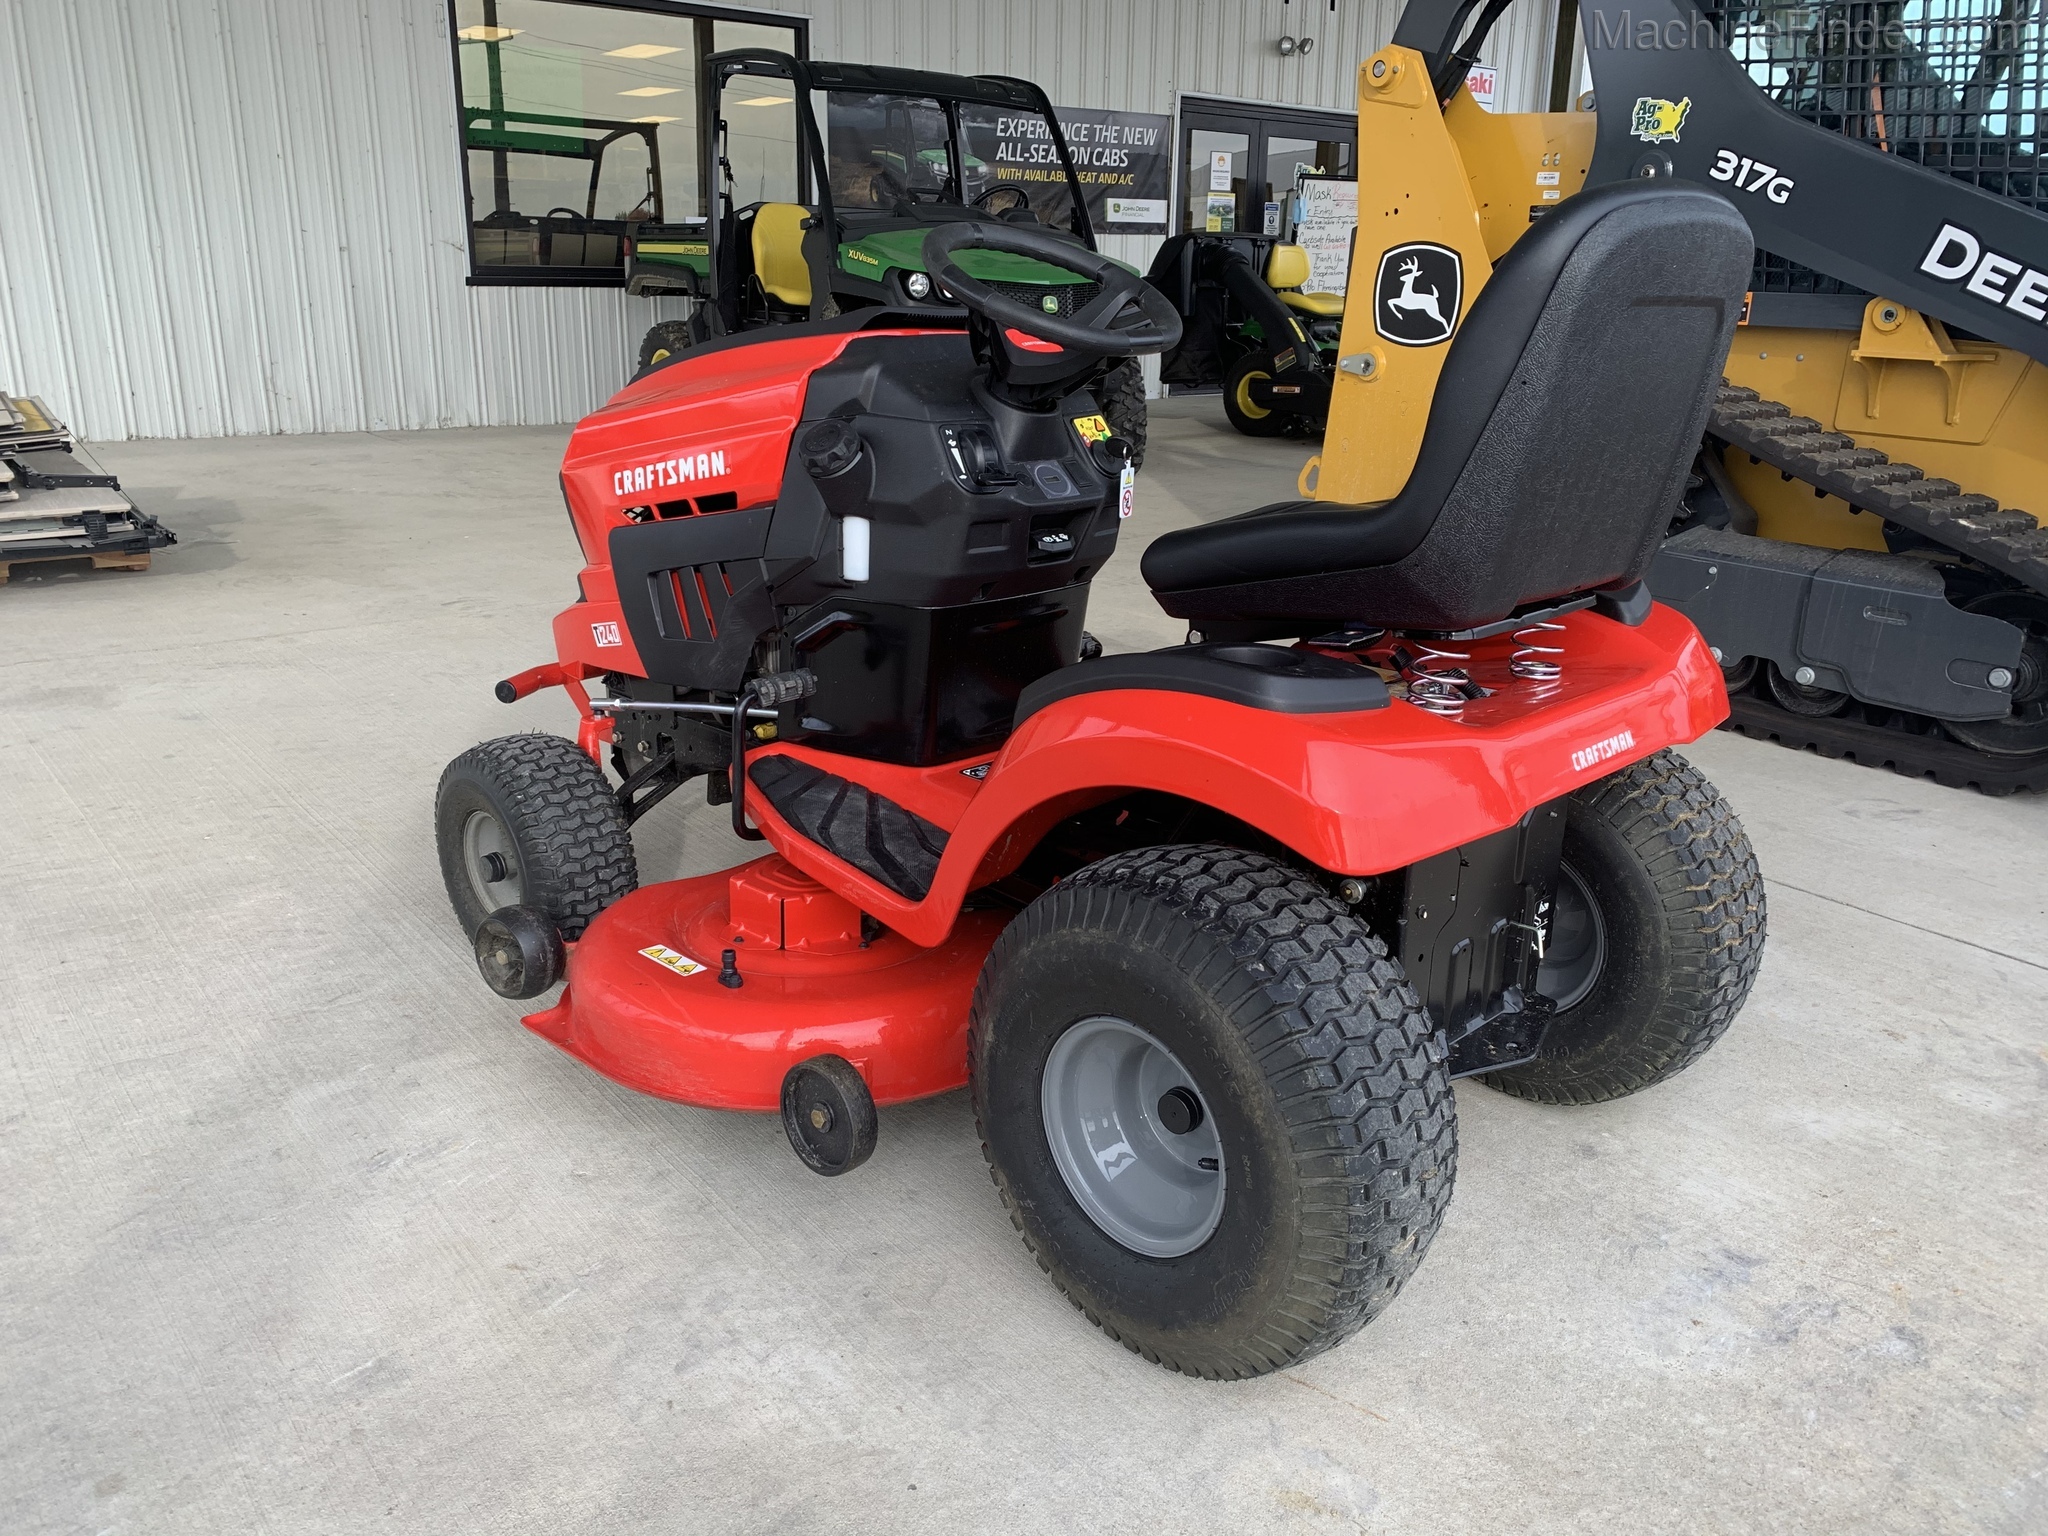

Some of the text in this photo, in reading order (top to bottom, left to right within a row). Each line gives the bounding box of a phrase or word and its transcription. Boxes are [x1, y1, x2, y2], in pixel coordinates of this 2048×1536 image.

[1636, 100, 1663, 118] Ag-
[996, 117, 1158, 146] EXPERINCE THE NEW
[1634, 116, 1660, 131] Pro
[995, 142, 1129, 167] ALL-SEAON CABS
[997, 168, 1022, 181] WITH
[1023, 169, 1069, 182] AVAILABL
[1098, 172, 1119, 185] AND
[1119, 173, 1135, 185] A/C
[1708, 149, 1796, 204] 317G
[1305, 183, 1332, 202] Mask
[682, 245, 707, 255] JOHN DEERE
[1920, 223, 2048, 325] DEE
[614, 450, 726, 496] CRAFTSMAN
[592, 624, 621, 646] T240
[1572, 730, 1634, 771] CRAFTSMAN
